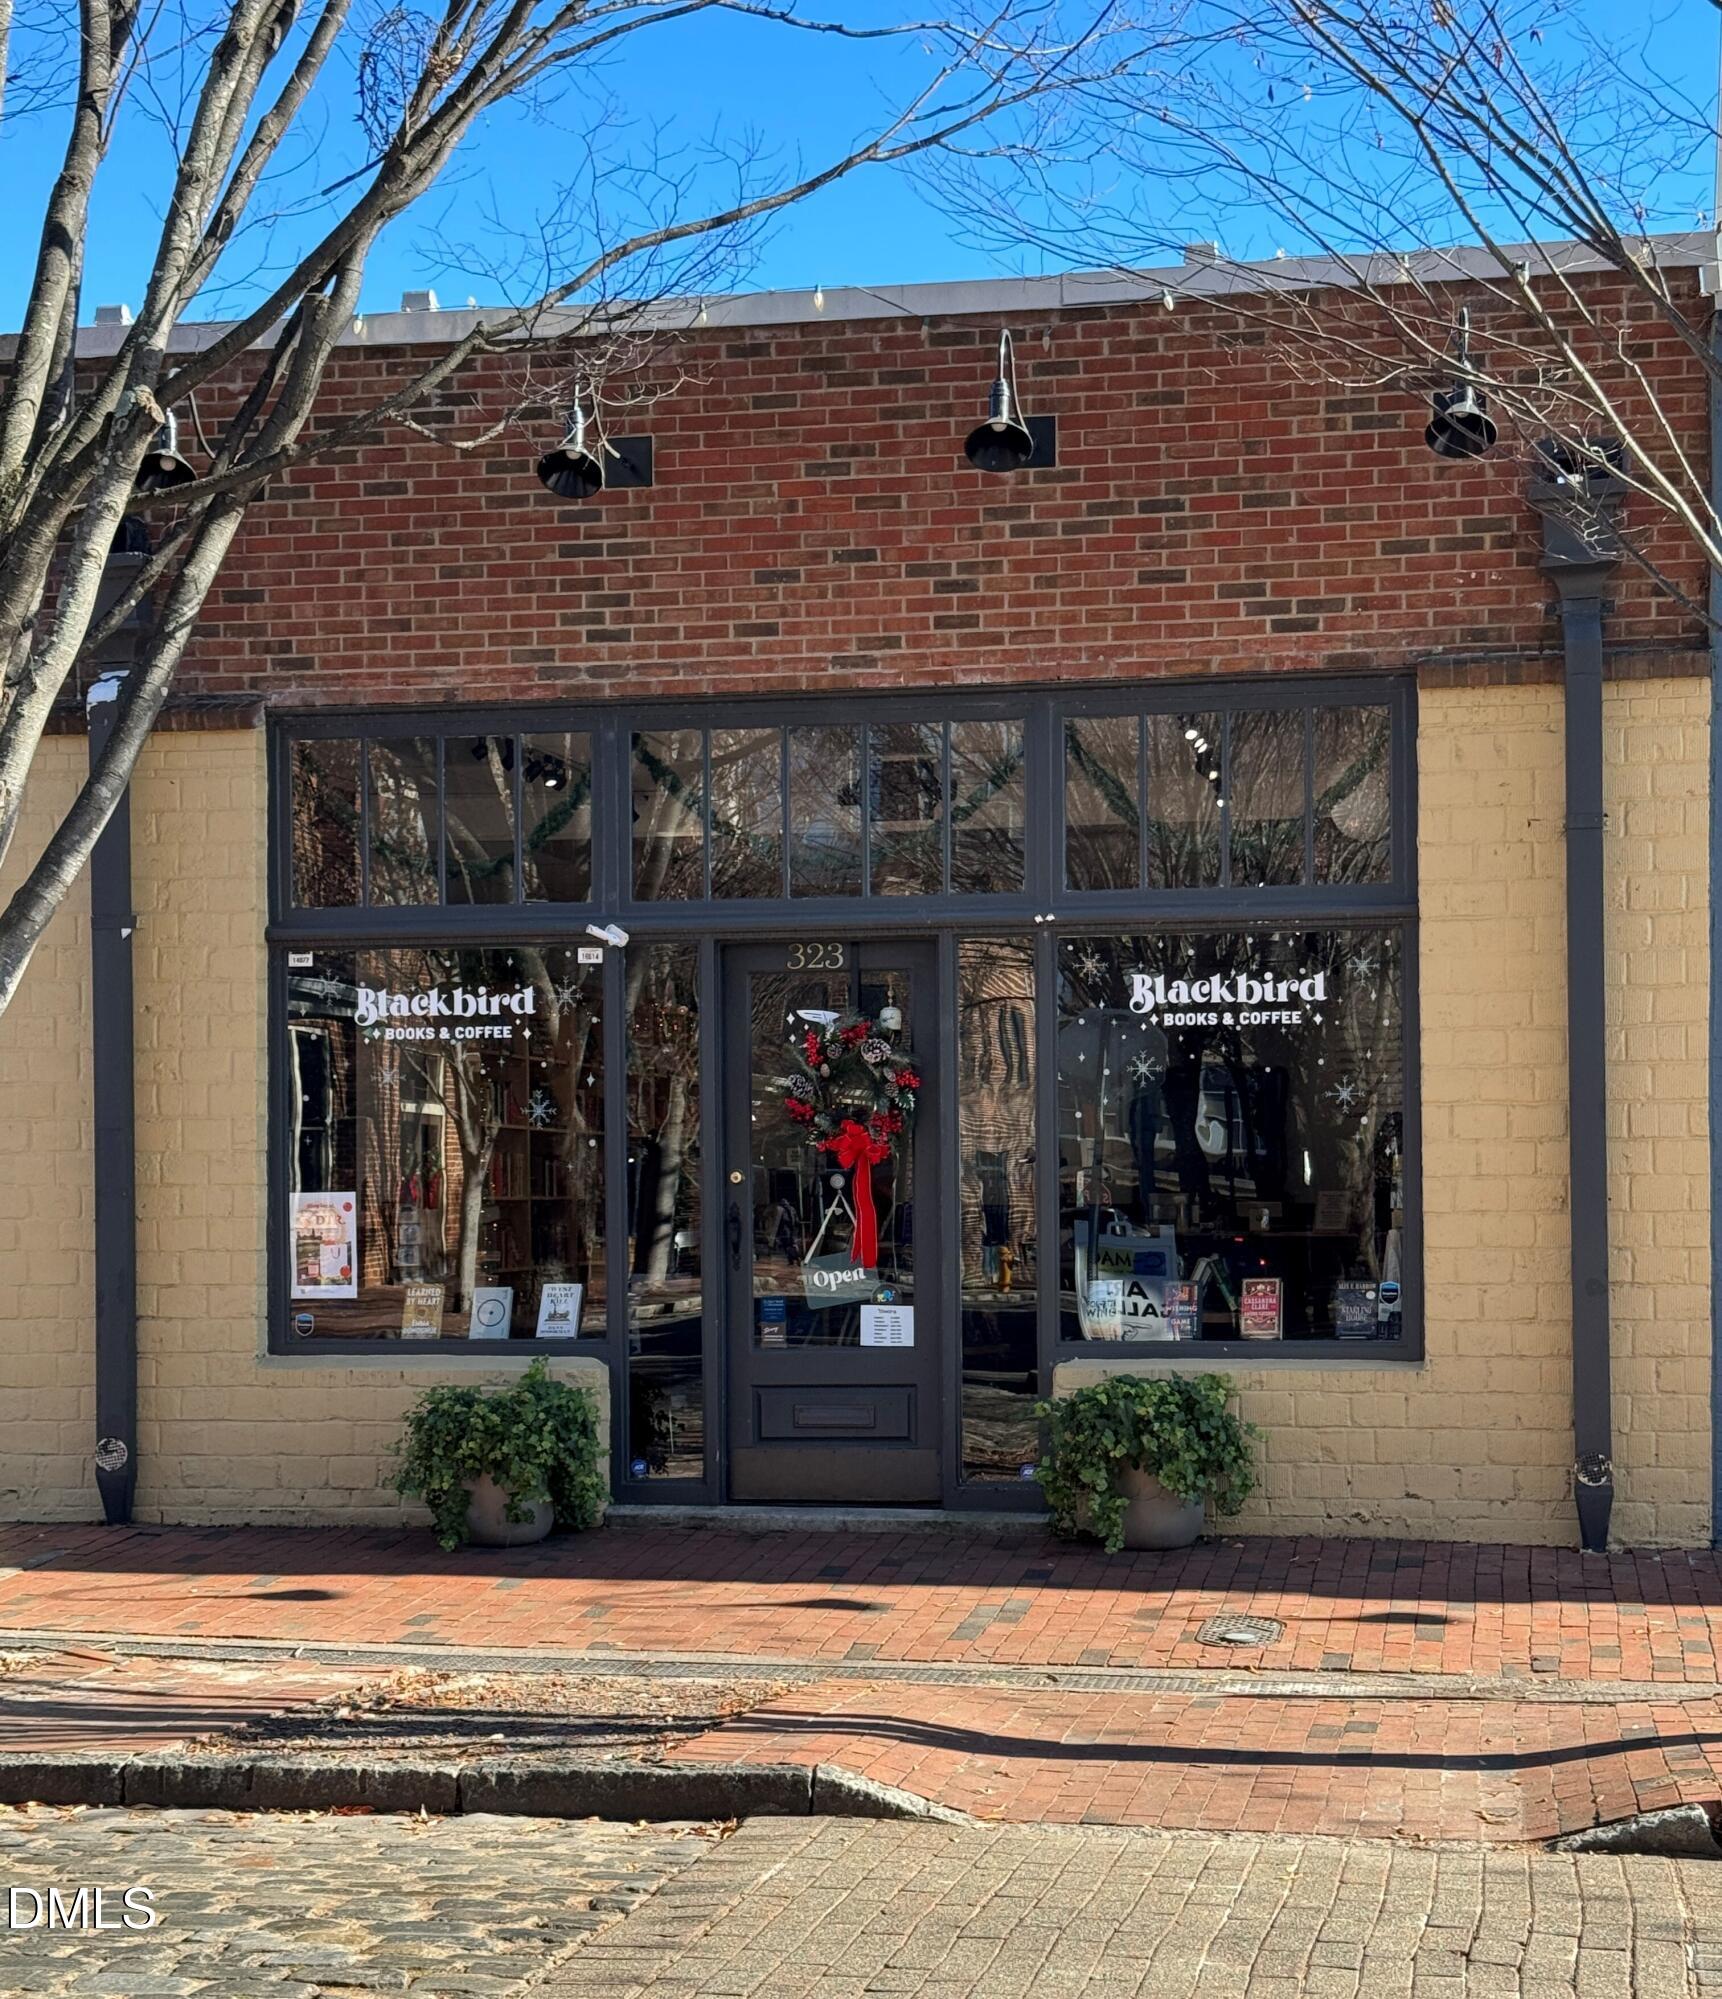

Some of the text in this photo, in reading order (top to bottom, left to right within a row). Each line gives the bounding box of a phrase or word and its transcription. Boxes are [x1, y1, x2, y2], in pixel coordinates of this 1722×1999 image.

[787, 943, 844, 970] 323
[1129, 970, 1328, 1015] Blackbird
[354, 985, 537, 1027] Blackbird
[1163, 1010, 1302, 1026] BOOKS & COFFEE
[385, 1026, 513, 1040] BOOKS & COFFEE
[813, 1267, 867, 1292] Open
[407, 1287, 441, 1297] LEARNED
[417, 1297, 440, 1305] HEART
